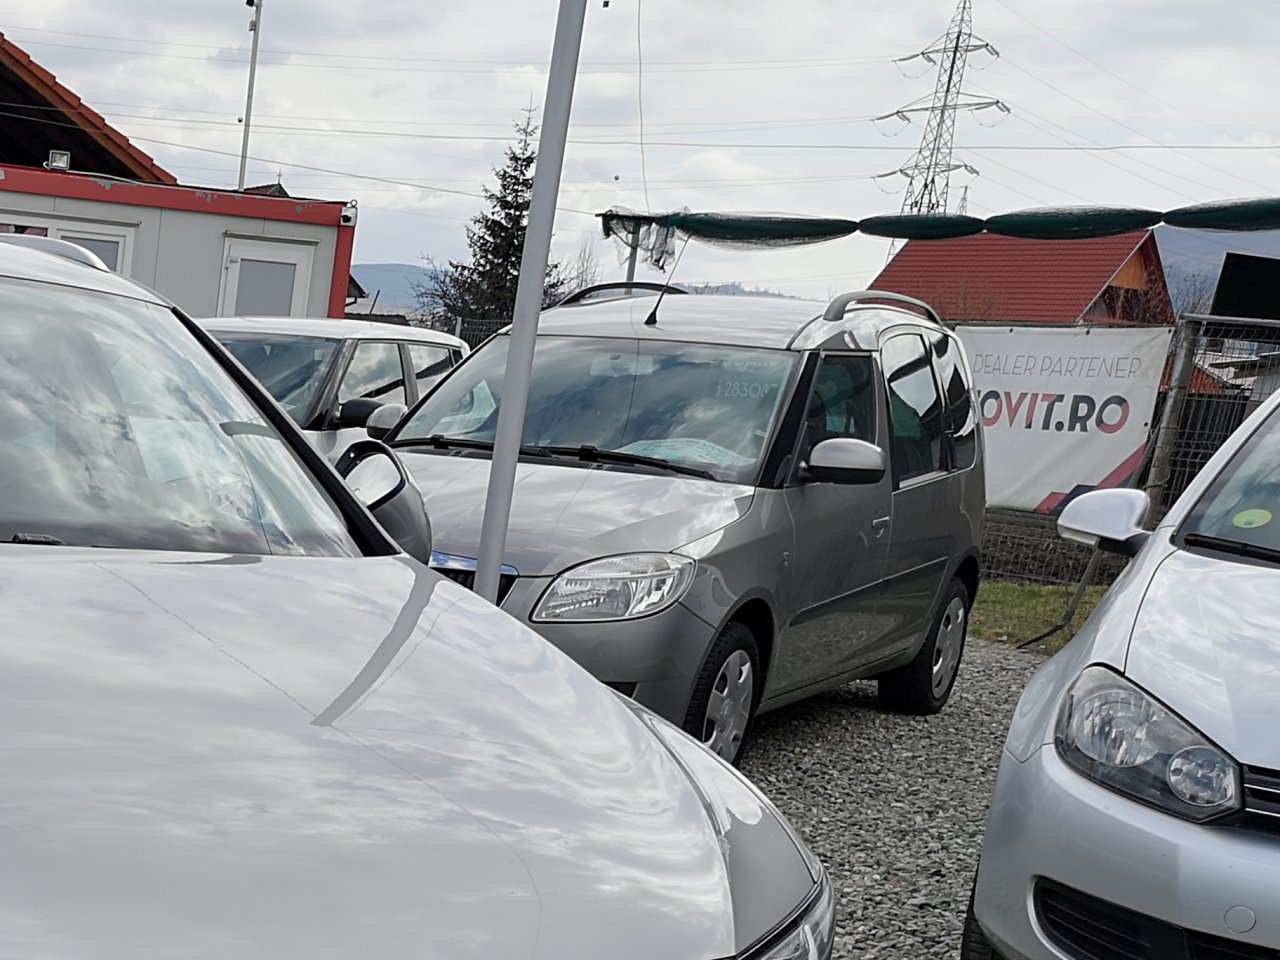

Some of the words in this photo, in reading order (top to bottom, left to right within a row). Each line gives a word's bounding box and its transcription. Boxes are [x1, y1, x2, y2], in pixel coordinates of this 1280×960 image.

[973, 353, 1036, 376] DEALER
[1039, 356, 1142, 379] PARTENER
[977, 389, 1130, 434] OVIT.RO
